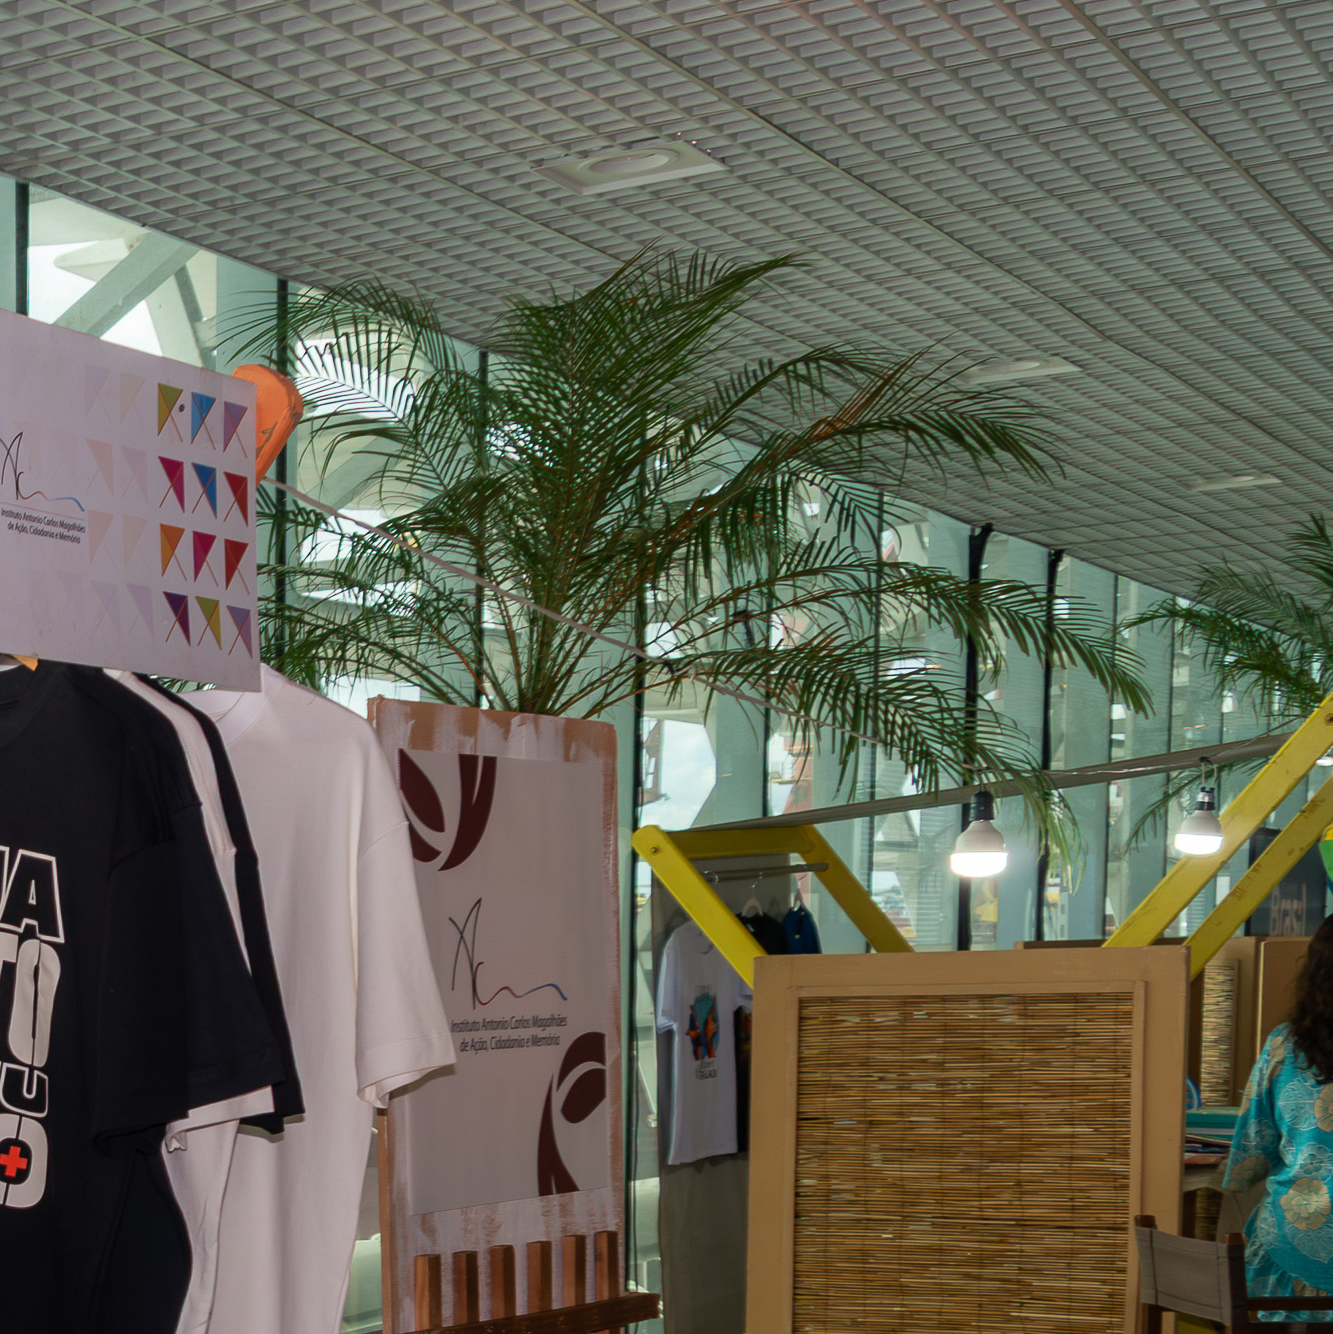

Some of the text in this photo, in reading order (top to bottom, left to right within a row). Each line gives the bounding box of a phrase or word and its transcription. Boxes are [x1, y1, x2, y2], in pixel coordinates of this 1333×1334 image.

[0, 507, 86, 534] Instituto Antonio Carlos Magalhães
[7, 521, 14, 530] de
[29, 525, 54, 539] Cidadania
[59, 532, 81, 545] Memória
[451, 1013, 568, 1033] Instituto Antonio Carlos Magalhães
[460, 1038, 470, 1052] de
[490, 1035, 525, 1051] Cidadania
[532, 1034, 560, 1047] Memória
